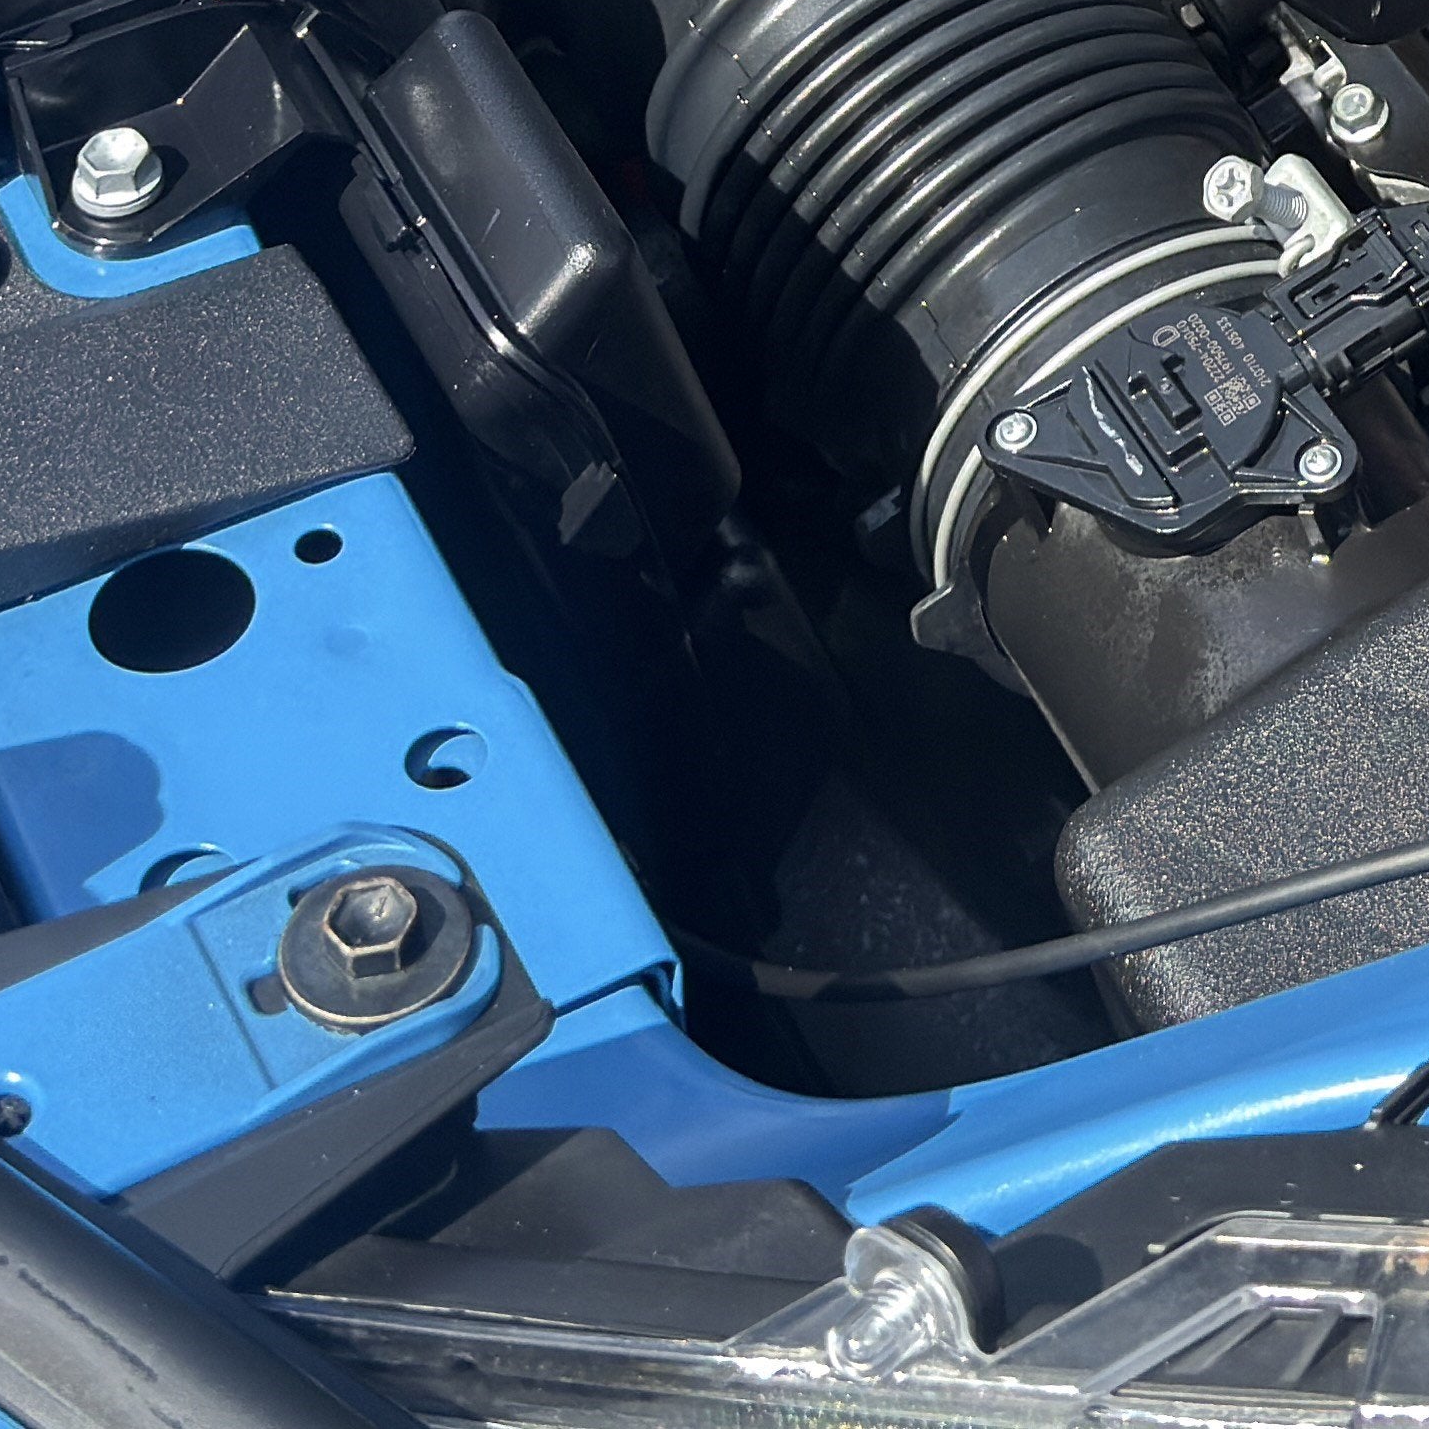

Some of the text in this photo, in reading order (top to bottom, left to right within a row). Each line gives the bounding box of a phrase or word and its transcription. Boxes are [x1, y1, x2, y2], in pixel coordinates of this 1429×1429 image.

[1152, 325, 1180, 347] D
[1176, 320, 1225, 383] 22204-75040
[1243, 353, 1271, 387] 210710
